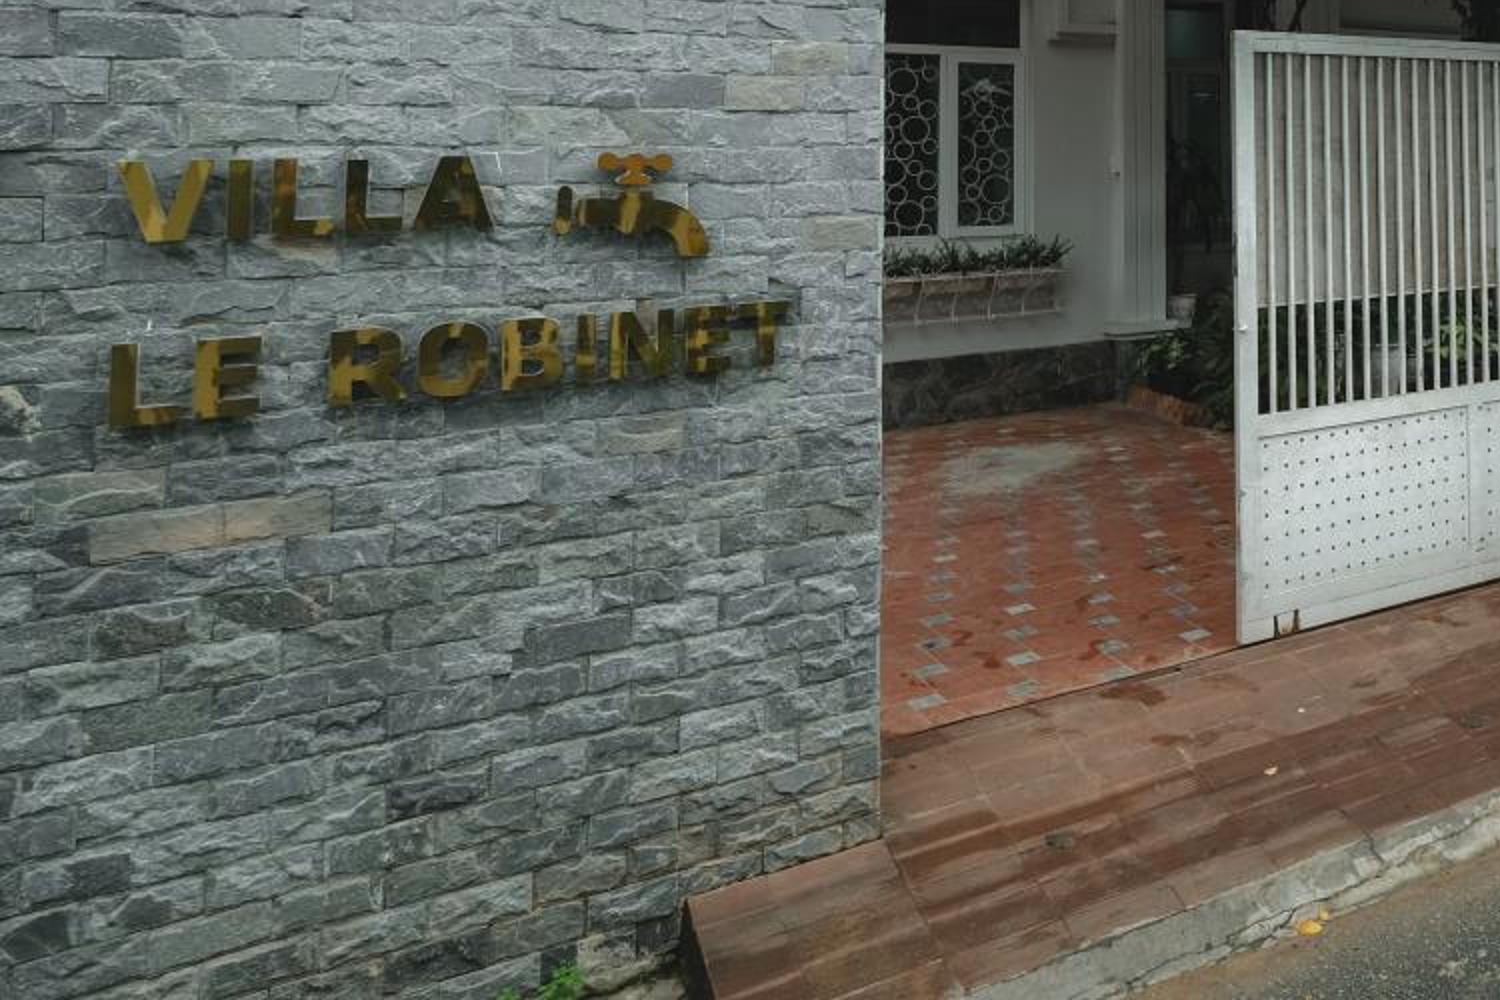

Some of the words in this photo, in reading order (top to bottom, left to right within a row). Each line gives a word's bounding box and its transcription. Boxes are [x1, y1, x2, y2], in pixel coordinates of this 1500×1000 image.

[117, 155, 494, 243] VILLA
[109, 333, 263, 428] LE
[328, 300, 791, 408] ROBINET
